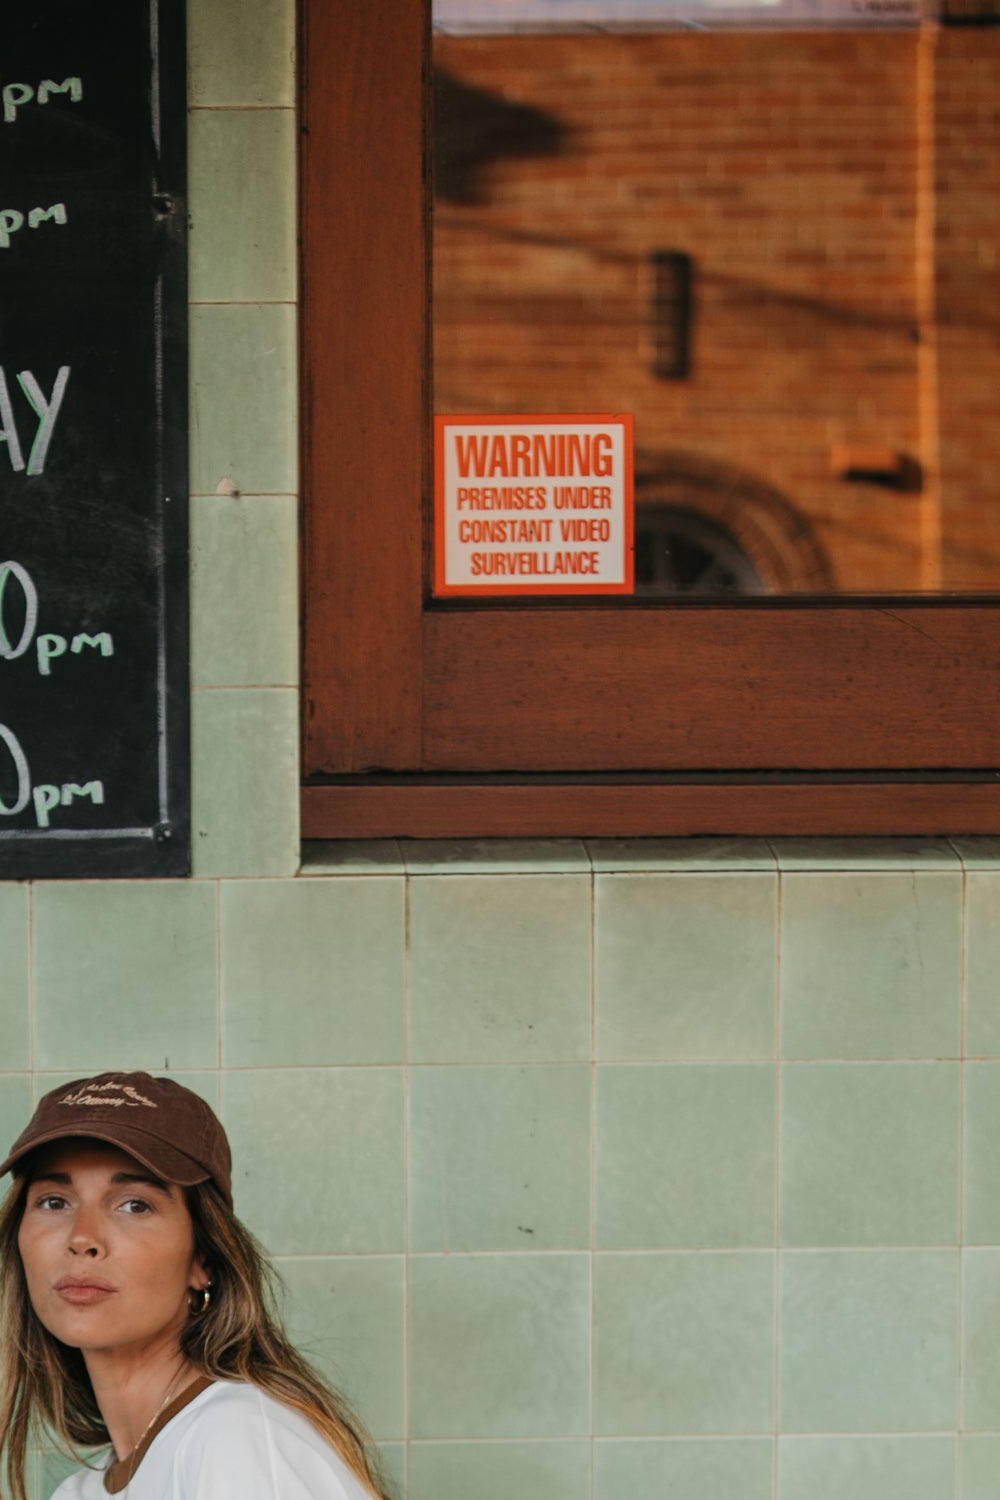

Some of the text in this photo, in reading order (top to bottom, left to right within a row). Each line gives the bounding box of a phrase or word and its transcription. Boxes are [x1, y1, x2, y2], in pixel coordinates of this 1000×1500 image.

[455, 433, 613, 478] WARNING
[457, 486, 611, 510] PREMISES UNDER
[459, 519, 610, 543] CONSTANT VIDEO
[471, 551, 598, 576] SURVEILLANCE
